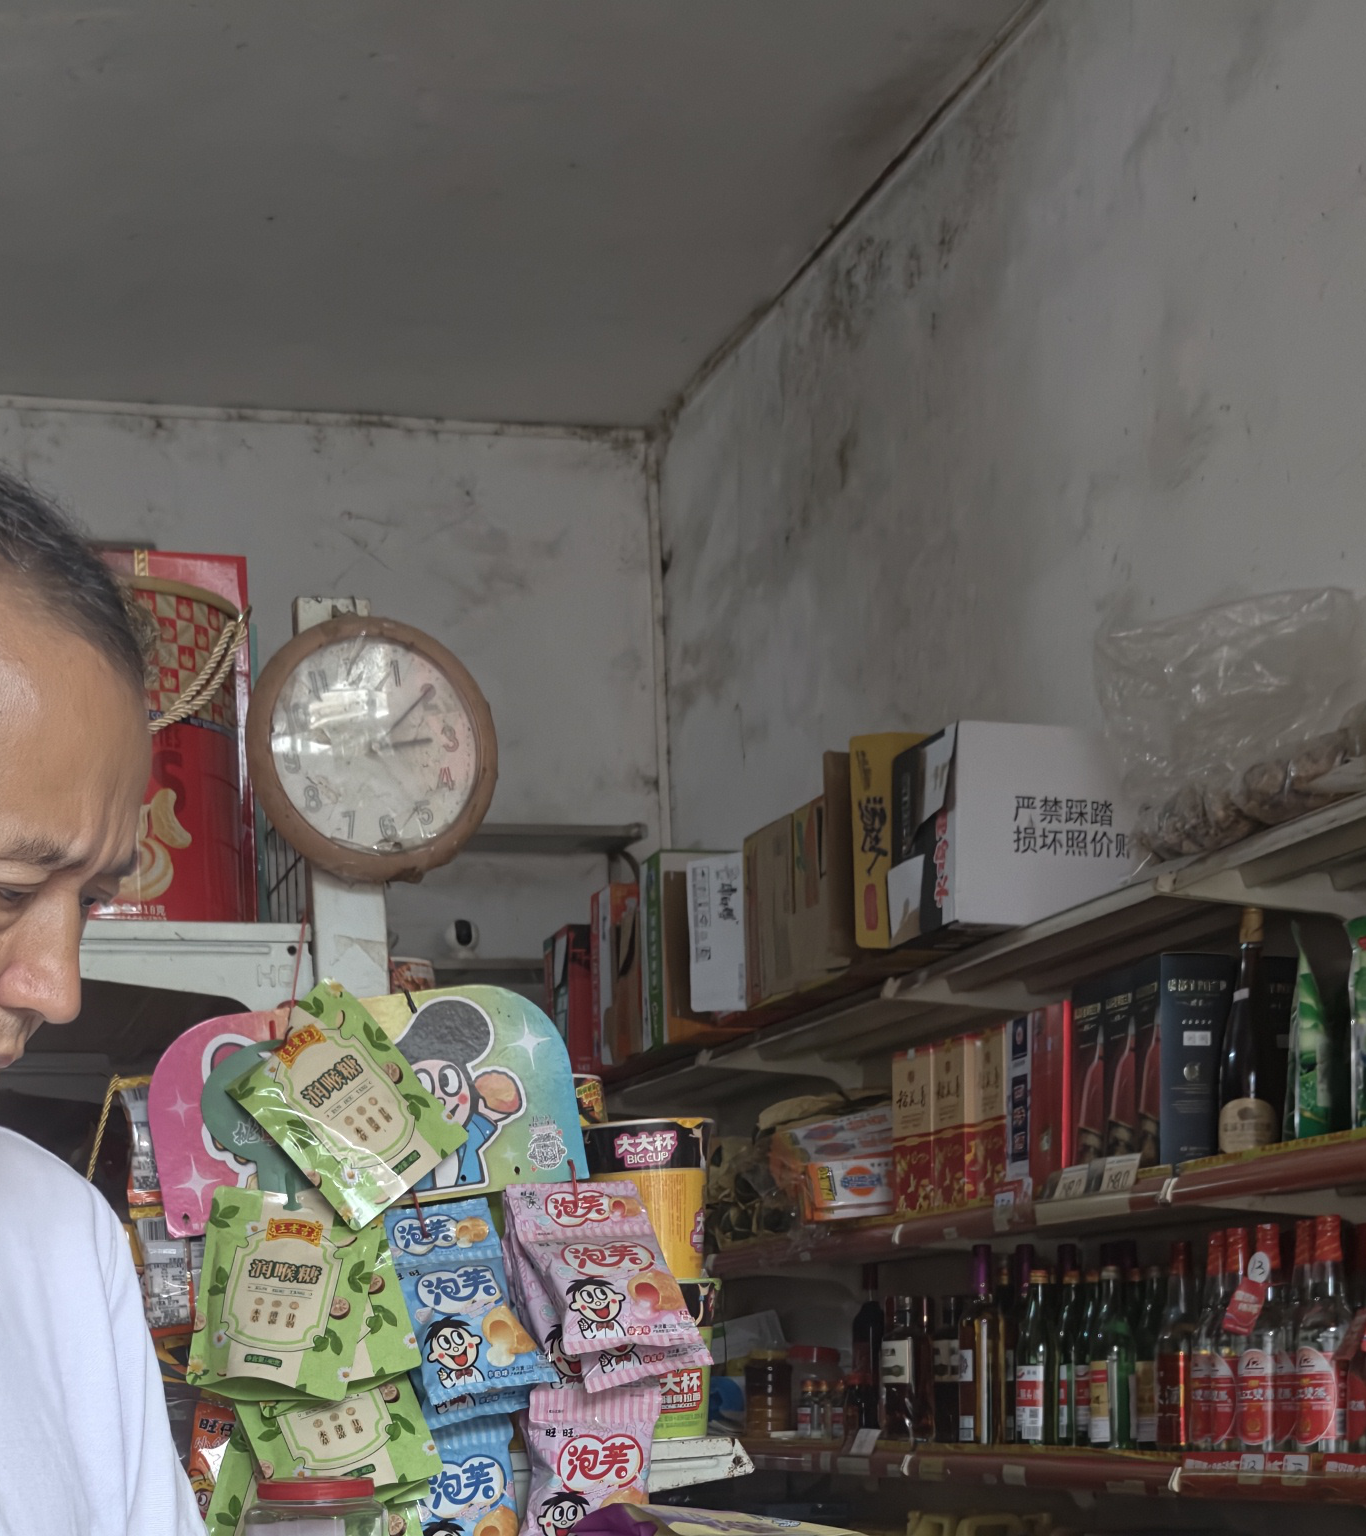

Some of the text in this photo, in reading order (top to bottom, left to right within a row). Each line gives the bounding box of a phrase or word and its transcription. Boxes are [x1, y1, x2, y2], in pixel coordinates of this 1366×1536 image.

[1014, 796, 1113, 827] 严禁踩踏
[300, 1054, 364, 1108] 润喉糖
[616, 1131, 676, 1154] 大大杯
[627, 1150, 670, 1164] BIG CUP
[554, 1195, 608, 1219] 泡芙
[277, 1223, 313, 1239] 王老吉
[570, 1243, 644, 1269] 泡芙
[248, 1258, 323, 1285] 润喉糖
[422, 1268, 498, 1306] 泡芙
[545, 1428, 573, 1438] 旺旺
[567, 1443, 636, 1481] 泡芙
[428, 1461, 496, 1510] 泡芙
